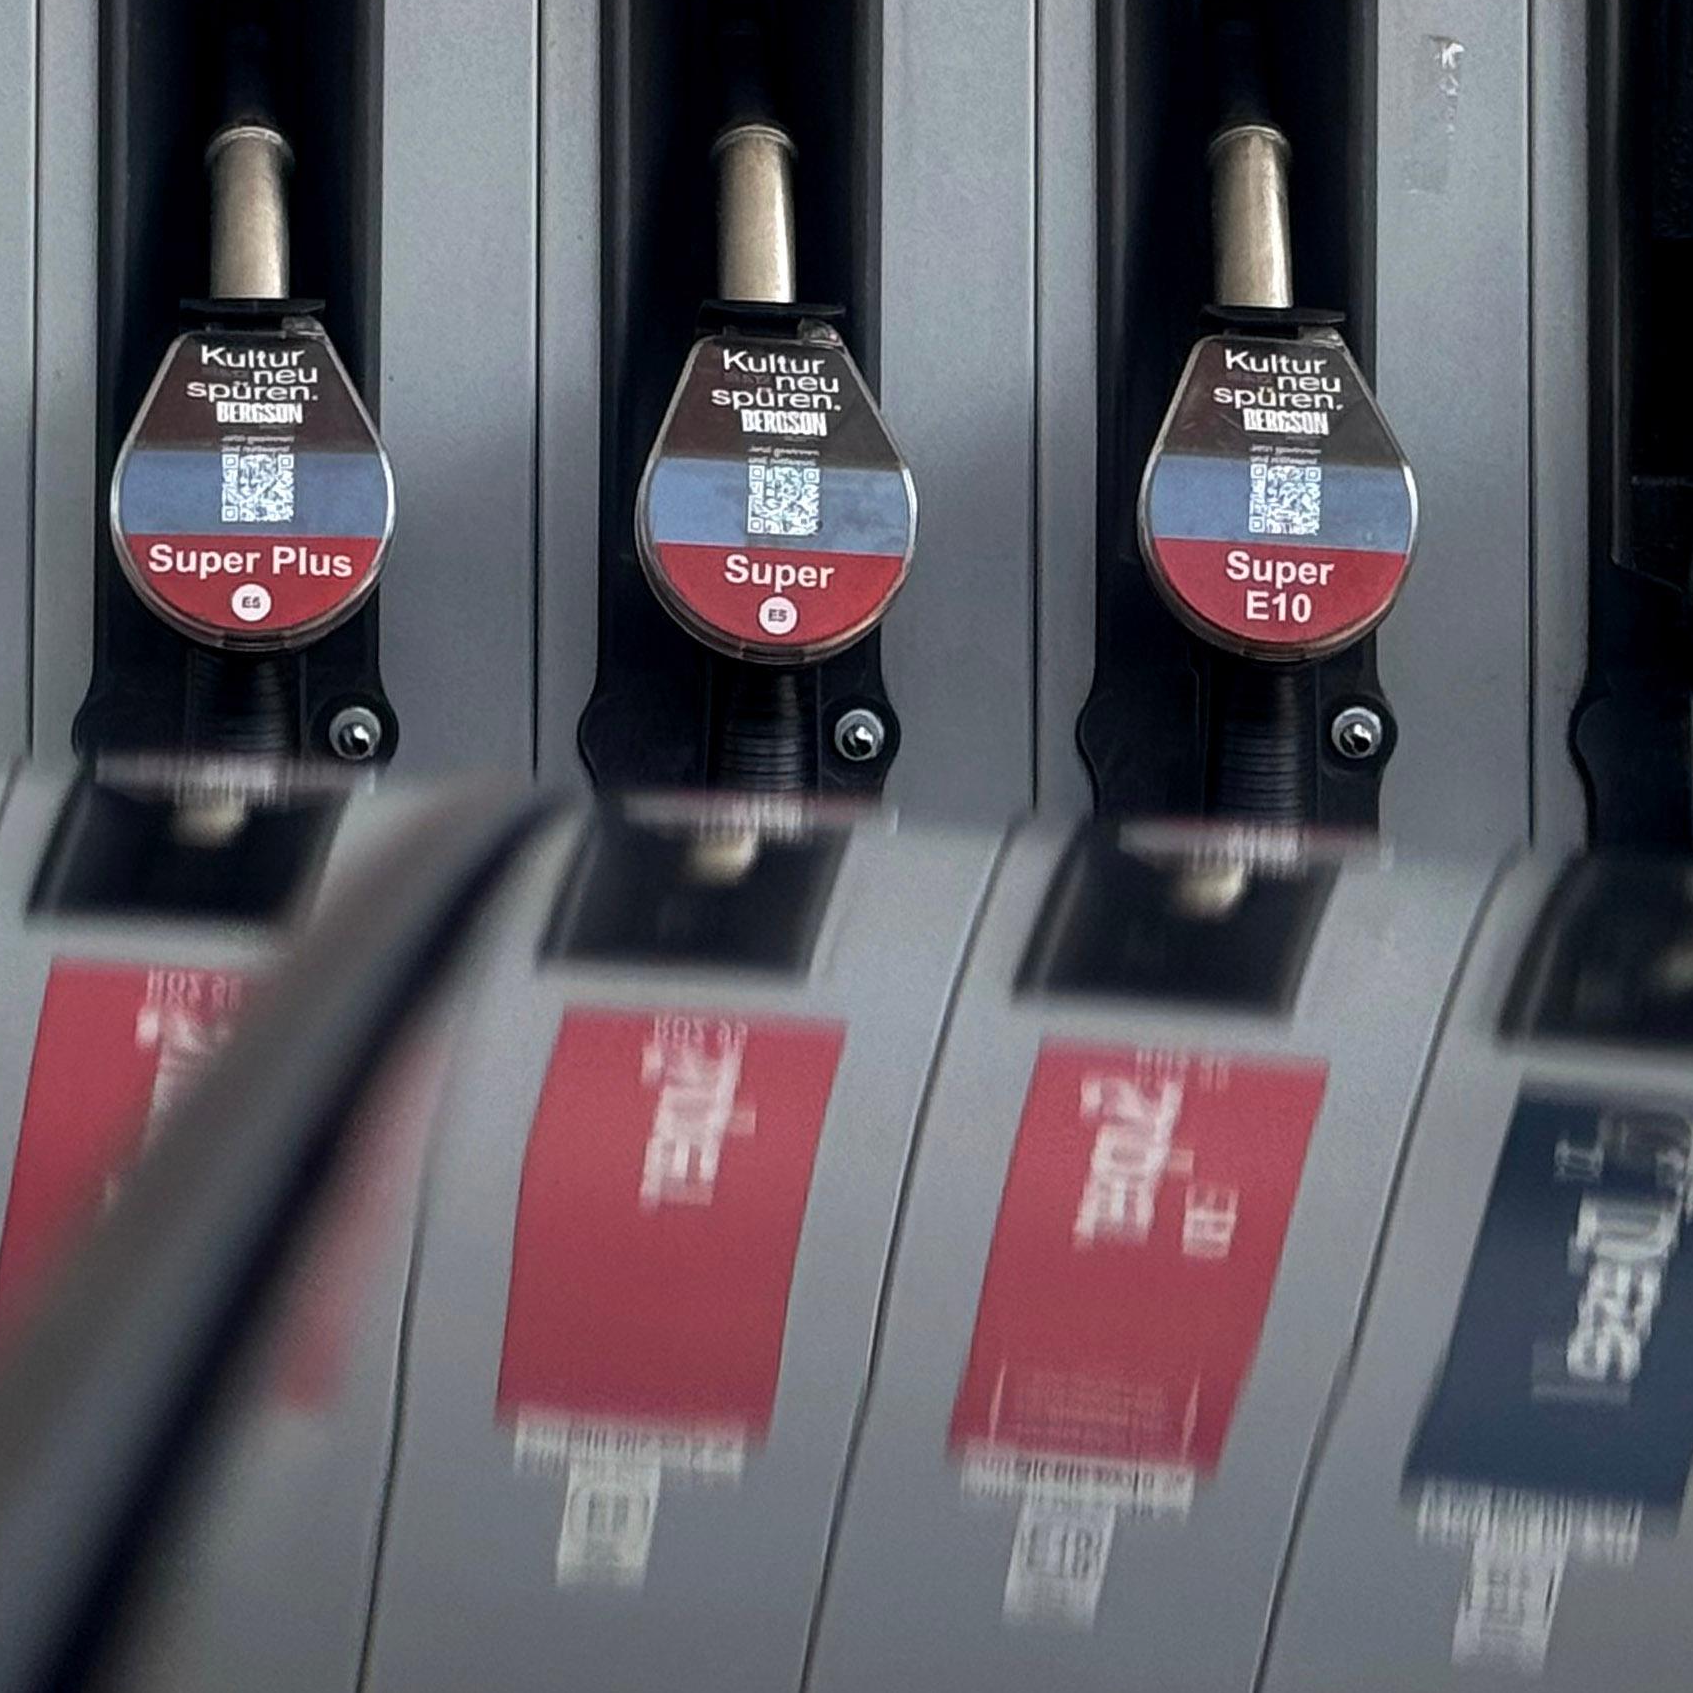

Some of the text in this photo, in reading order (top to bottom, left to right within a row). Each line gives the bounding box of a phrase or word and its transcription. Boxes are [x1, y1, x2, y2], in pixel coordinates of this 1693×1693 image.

[201, 344, 306, 368] Kultur
[722, 348, 826, 376] Kultur
[1224, 348, 1327, 375] Kultur
[253, 367, 319, 386] neu
[775, 375, 840, 395] neu
[1276, 374, 1342, 394] neu
[185, 380, 320, 404] spüren.
[711, 388, 842, 412] spüren.
[1213, 385, 1344, 412] spüren.
[148, 543, 353, 579] Super Plus
[723, 553, 835, 593] Super
[1226, 549, 1335, 589] Super
[1245, 589, 1312, 623] E10
